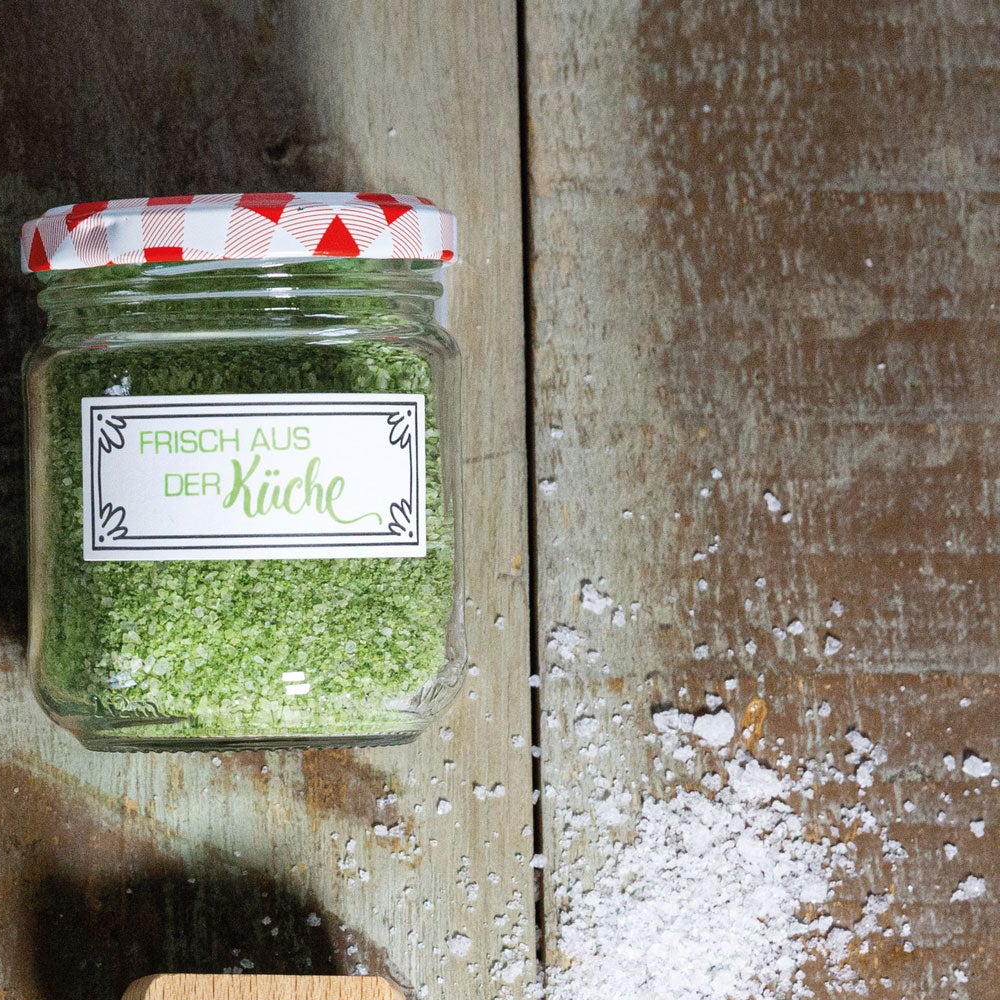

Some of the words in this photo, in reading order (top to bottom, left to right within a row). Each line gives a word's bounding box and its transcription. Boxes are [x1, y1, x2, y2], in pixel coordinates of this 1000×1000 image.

[139, 428, 240, 454] FRISCH
[250, 426, 311, 452] AUS
[164, 472, 221, 497] DER
[222, 454, 383, 525] Küche
